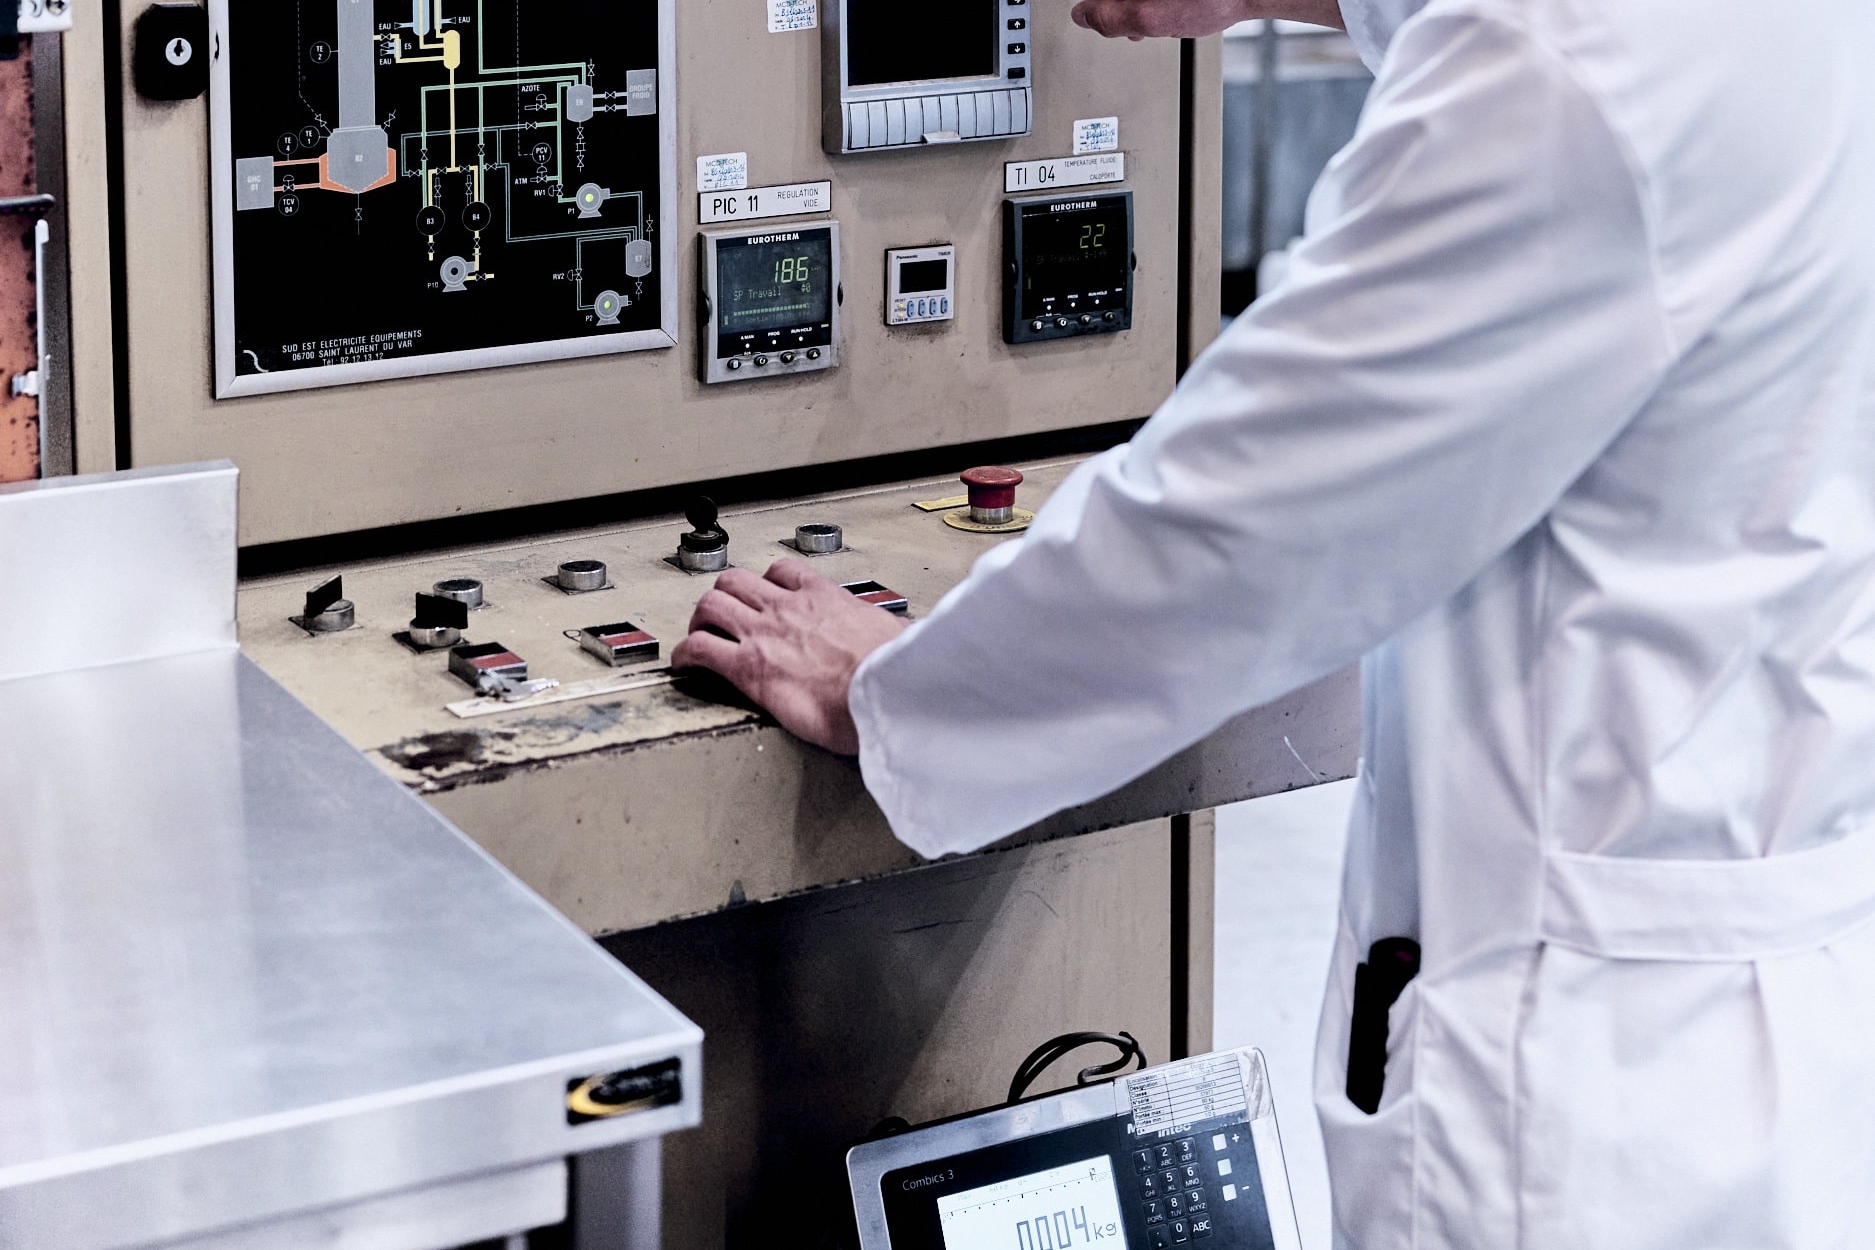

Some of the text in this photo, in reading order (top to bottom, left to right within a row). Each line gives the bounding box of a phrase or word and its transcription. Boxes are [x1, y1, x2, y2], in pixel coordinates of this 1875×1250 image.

[458, 16, 470, 24] EAU
[380, 58, 392, 66] EAU
[628, 84, 652, 92] GROUPE
[632, 92, 650, 100] FROID
[305, 130, 312, 138] TE
[1064, 158, 1097, 168] TEMPERATURE
[1016, 166, 1055, 185] TI 04
[778, 188, 818, 200] REGULATION
[283, 198, 295, 206] TCV
[714, 195, 758, 216] PIC 11
[804, 199, 818, 208] VIDE
[1050, 201, 1097, 212] EUROTHERM
[748, 233, 800, 244] EUROTHERM
[1080, 224, 1105, 248] 22
[774, 256, 808, 284] 186
[734, 286, 782, 301] SP Travail
[282, 330, 422, 354] SUD EST ELECTRICITE EQUIPEMENTS
[318, 349, 340, 358] SAINT
[345, 344, 378, 354] LAURENT
[382, 342, 393, 350] DU
[398, 340, 412, 348] VAR
[1161, 1147, 1168, 1156] 2
[1182, 1142, 1188, 1152] 3
[1142, 1152, 1146, 1162] 1
[1187, 1167, 1194, 1176] 6
[902, 1170, 954, 1191] Combics 3
[1146, 1178, 1152, 1186] 4
[1166, 1172, 1172, 1182] 5
[1185, 1178, 1200, 1186] MNO
[1192, 1192, 1198, 1202] 9
[1171, 1198, 1178, 1207] 8
[1188, 1203, 1206, 1212] WXYZ
[1150, 1204, 1156, 1212] 7
[1147, 1214, 1162, 1223] PQRS
[1176, 1223, 1182, 1232] 0
[1192, 1220, 1211, 1232] ABC
[1094, 1222, 1117, 1241] kg
